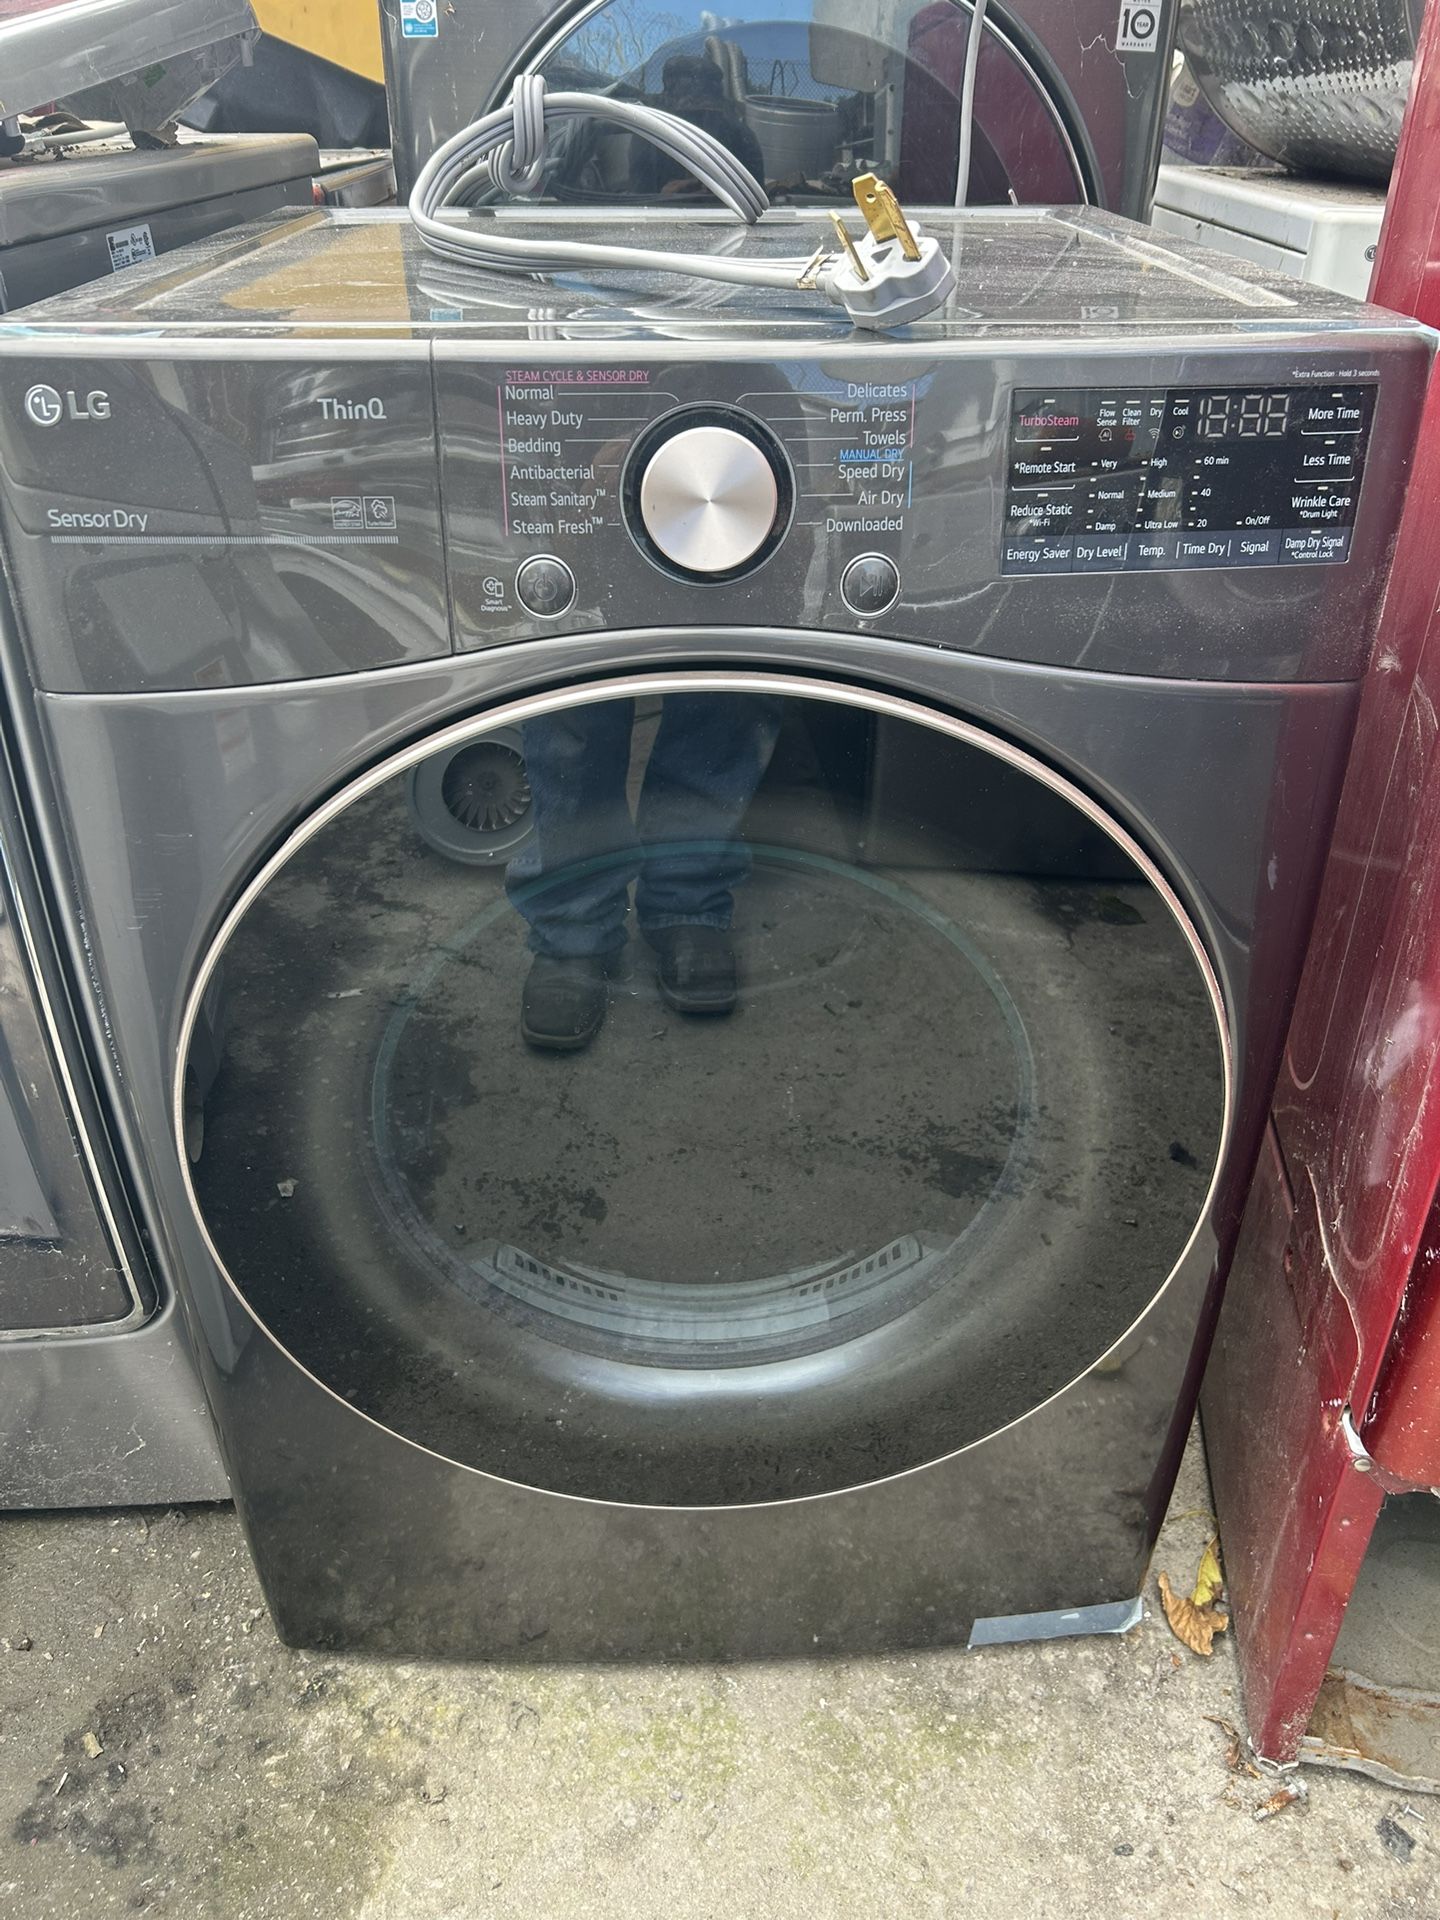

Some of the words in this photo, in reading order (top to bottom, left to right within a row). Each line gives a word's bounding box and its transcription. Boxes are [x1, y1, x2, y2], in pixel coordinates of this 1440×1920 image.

[1123, 9, 1155, 39] 10
[505, 370, 540, 382] STEAM
[542, 370, 574, 382] CYCLE
[576, 370, 584, 382] &
[586, 370, 627, 382] SENSOR
[629, 370, 650, 382] DRY
[505, 384, 554, 401] Normal
[847, 382, 907, 399] Delicates
[66, 390, 112, 420] LG
[316, 397, 388, 420] ThinQ
[1099, 408, 1116, 417] Flow
[1122, 407, 1142, 417] Clean
[1149, 407, 1163, 418] Dry
[1172, 406, 1189, 416] Cool
[506, 410, 548, 430] Heavy
[551, 410, 584, 430] Duty
[830, 407, 868, 424] Perm.
[871, 407, 907, 423] Press
[1308, 407, 1334, 420] More
[1336, 406, 1360, 419] Time
[1019, 414, 1079, 427] TurboSteam
[1096, 417, 1117, 427] Sense
[1121, 417, 1140, 426] Filter
[862, 429, 906, 446] Towels
[508, 437, 562, 457] Bedding
[839, 448, 881, 460] MANUAL
[884, 448, 905, 459] DRY
[1053, 460, 1076, 473] Start
[1100, 459, 1118, 470] Very
[1150, 458, 1168, 470] High
[1203, 456, 1214, 466] 60
[1215, 456, 1230, 465] min
[1303, 454, 1326, 467] Less
[1327, 453, 1352, 466] Time
[510, 464, 595, 481] Antibacterial
[838, 463, 878, 483] Speed
[882, 463, 905, 482] Dry
[511, 491, 548, 507] Steam
[1097, 490, 1125, 500] Normal
[1147, 489, 1177, 499] Medium
[1200, 487, 1212, 497] 40
[857, 490, 877, 506] Air
[881, 490, 904, 509] Dry
[1291, 496, 1327, 509] Wrinkle
[1328, 495, 1352, 507] Care
[1010, 505, 1044, 517] Reduce
[1045, 503, 1073, 516] Static
[1321, 509, 1339, 520] Light
[513, 519, 554, 535] Steam
[826, 515, 904, 533] Downloaded
[1095, 521, 1117, 533] Damp
[1144, 520, 1163, 529] Ultra
[1163, 519, 1179, 529] Low
[1196, 518, 1208, 528] 20
[1244, 515, 1271, 526] On/Off
[1182, 543, 1206, 555] Time
[1207, 542, 1226, 557] Dry
[1240, 540, 1270, 556] Signal
[1284, 537, 1307, 551] Damp
[1306, 536, 1321, 551] Dry
[1321, 535, 1345, 550] Signal
[1006, 548, 1041, 563] Energy
[1042, 547, 1071, 559] Saver
[1076, 546, 1094, 561] Dry
[1096, 545, 1123, 558] Level
[1138, 544, 1167, 559] Temp.
[1318, 549, 1334, 559] Lock
